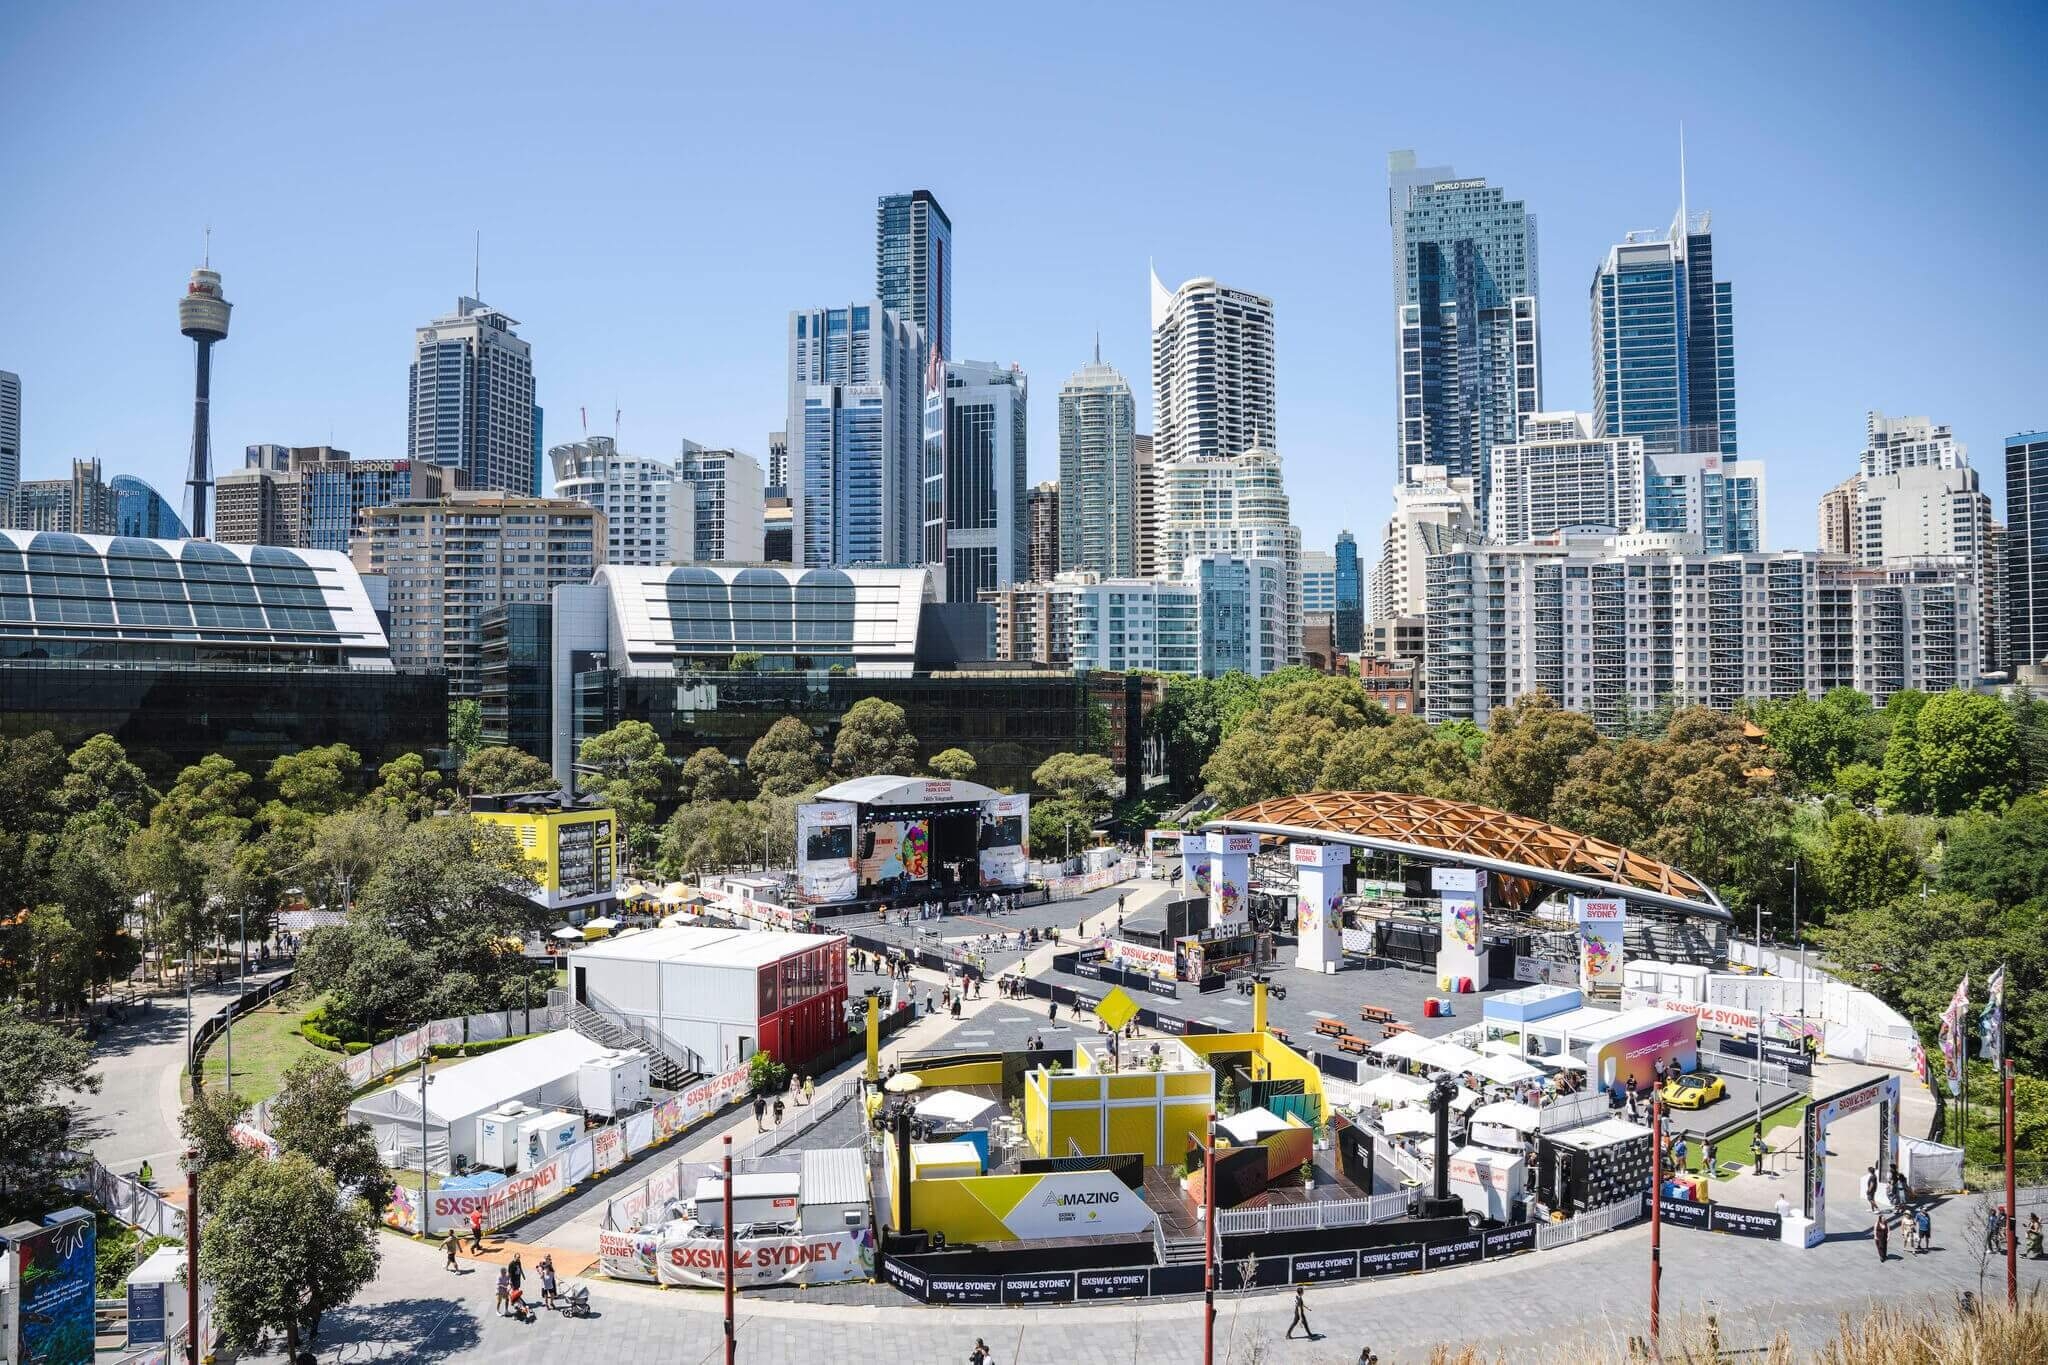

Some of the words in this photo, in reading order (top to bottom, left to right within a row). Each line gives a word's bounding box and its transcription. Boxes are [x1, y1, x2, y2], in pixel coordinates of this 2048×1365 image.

[1434, 183, 1460, 191] WORLD
[1461, 181, 1487, 189] TOWER
[1229, 291, 1258, 304] MERITON
[1587, 910, 1617, 918] SYDNEY
[1215, 921, 1238, 939] BEER
[1121, 946, 1142, 959] SXSW
[1150, 952, 1174, 965] SYDNE
[1625, 1039, 1670, 1060] PORSCHE
[686, 1084, 712, 1107] SXSW
[721, 1064, 752, 1089] SYDNEY
[1860, 1087, 1879, 1102] SYDNEY
[435, 1195, 490, 1216] SXSW
[507, 1162, 558, 1200] SYDNEY
[1675, 1204, 1705, 1216] SYDNEY
[1715, 1211, 1738, 1221] SXSW
[1746, 1215, 1777, 1226] SYDNEY
[600, 1234, 624, 1245] SXSW
[1487, 1235, 1505, 1245] SXSW
[1509, 1228, 1533, 1240] SYDNEY
[600, 1246, 634, 1258] SYDNEY
[671, 1248, 726, 1268] SXSW
[757, 1241, 841, 1267] SYDNEY
[1428, 1246, 1447, 1256] SXSW
[1454, 1240, 1480, 1251] SYDNEY
[1296, 1261, 1317, 1270] SXSW
[1325, 1257, 1354, 1268] SYDNEY
[1363, 1254, 1384, 1263] SXSW
[1392, 1250, 1419, 1260] SYDNEY
[902, 1270, 924, 1287] SYDNEY
[933, 1282, 955, 1290] SXSW
[964, 1281, 997, 1290] SYDNEY
[1006, 1281, 1030, 1290] SXSW
[1038, 1279, 1071, 1288] SYDNEY
[1081, 1278, 1105, 1286] SXSW
[1113, 1275, 1145, 1284] SYDNEY
